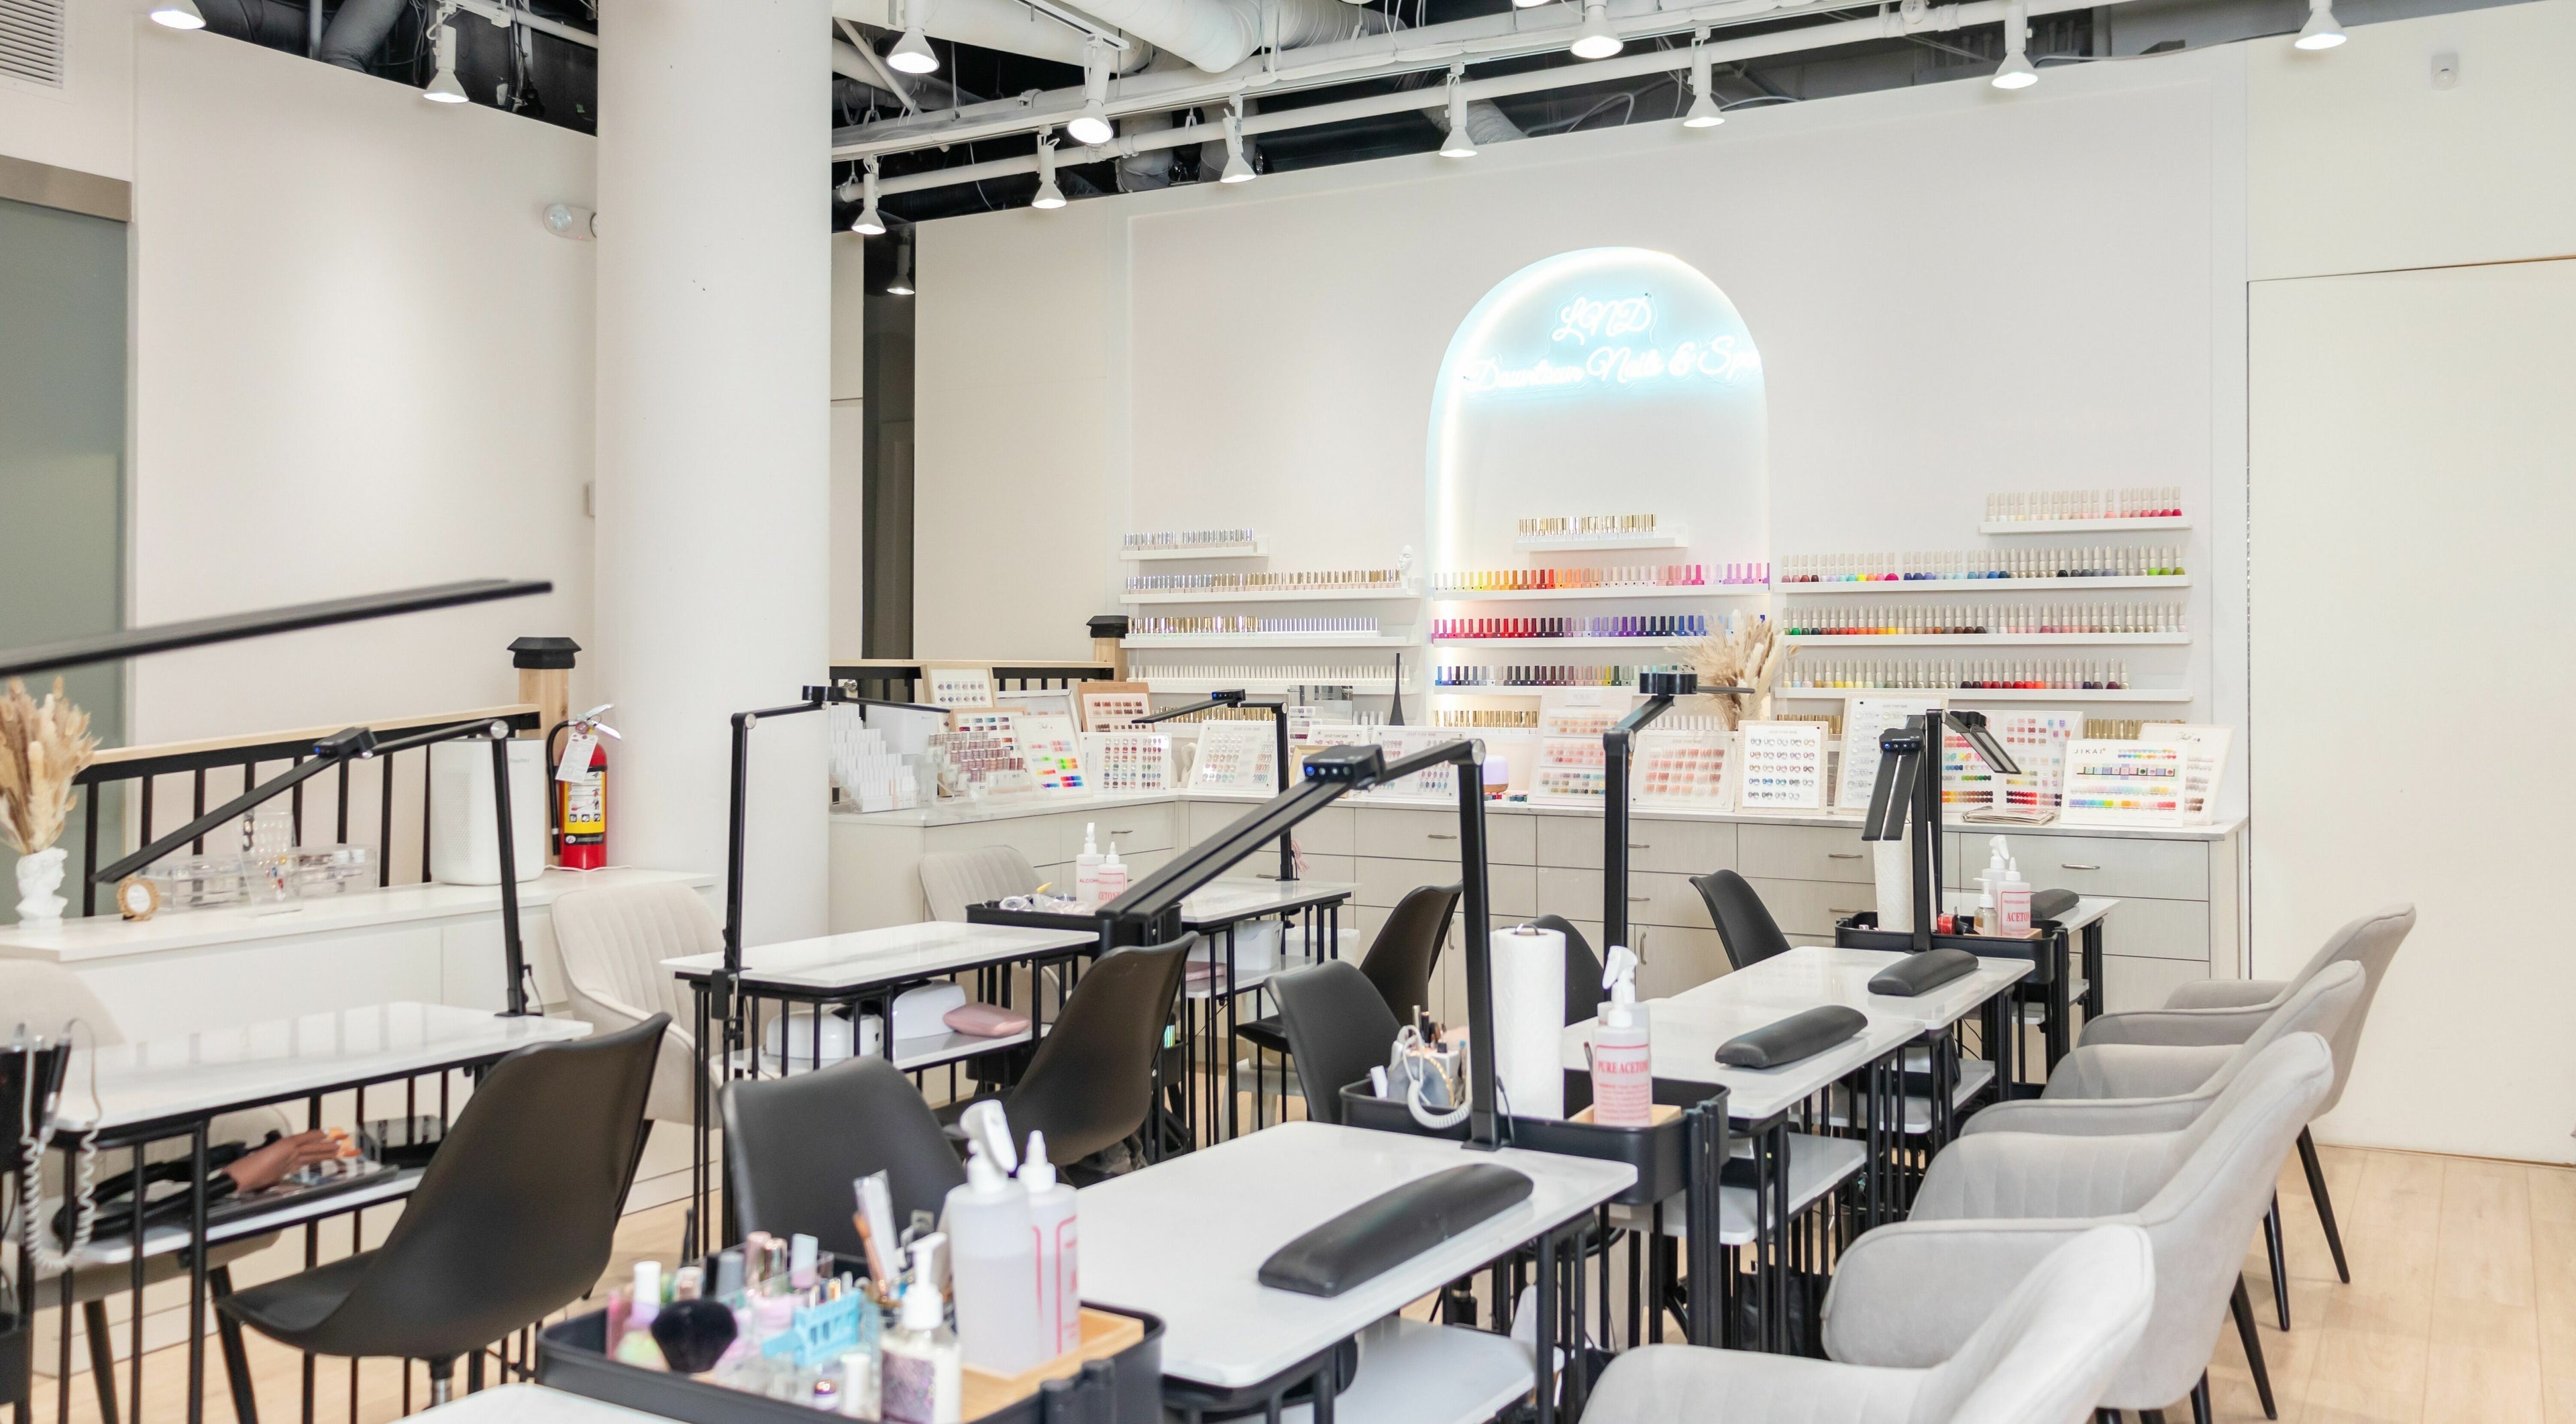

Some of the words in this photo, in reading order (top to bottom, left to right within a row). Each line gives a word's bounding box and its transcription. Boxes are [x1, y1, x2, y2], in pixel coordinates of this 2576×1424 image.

[1552, 296, 1652, 345] LND
[1587, 346, 1665, 383] Nails
[1668, 341, 1697, 376] &
[1598, 1060, 1617, 1074] PURE
